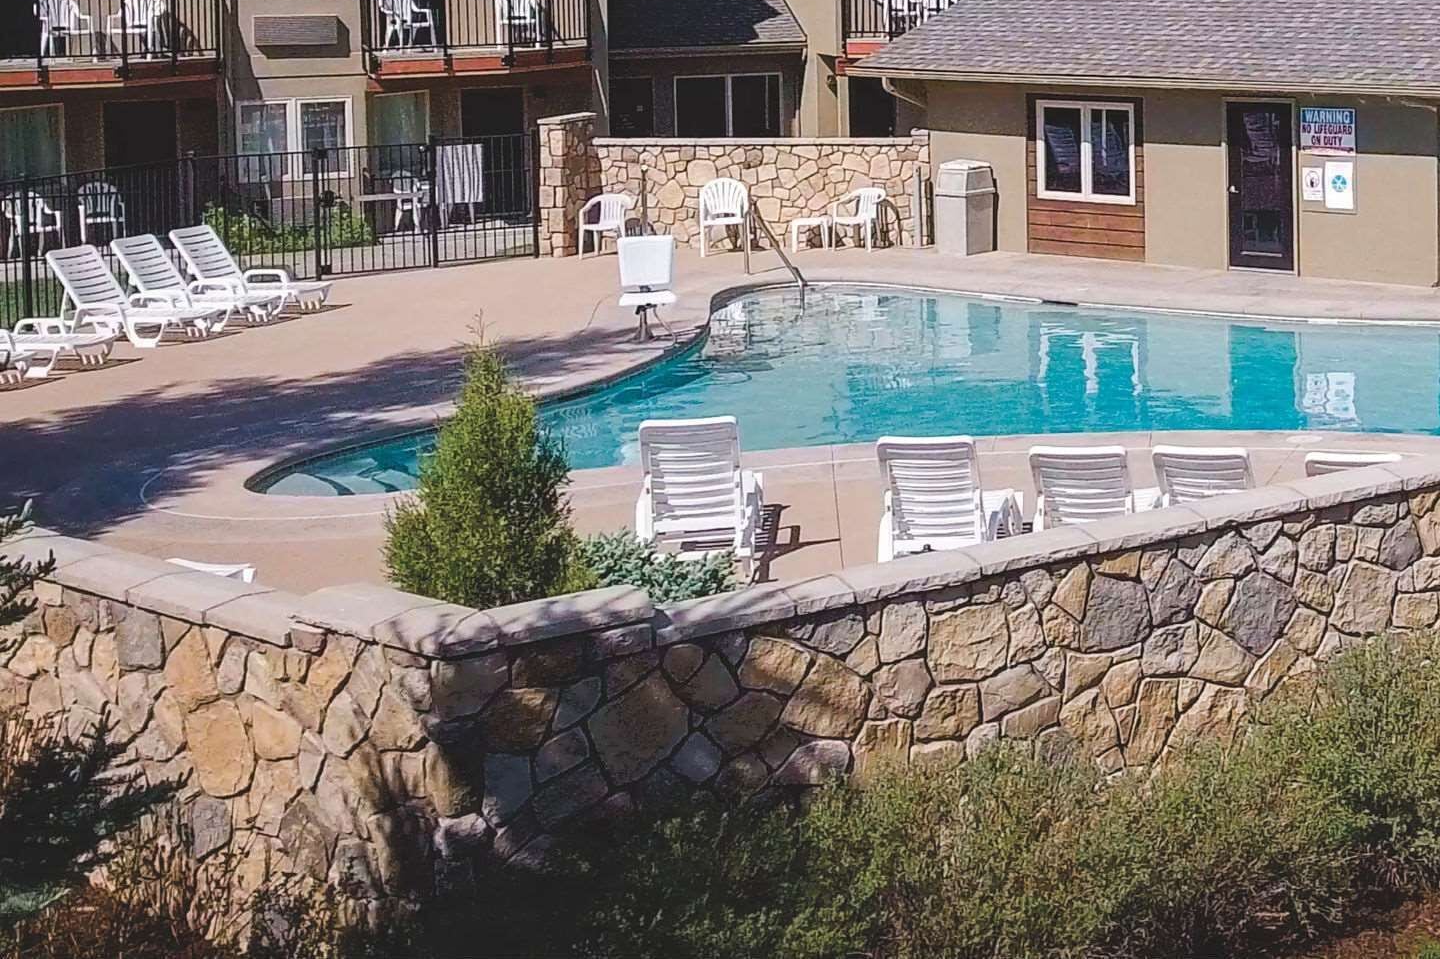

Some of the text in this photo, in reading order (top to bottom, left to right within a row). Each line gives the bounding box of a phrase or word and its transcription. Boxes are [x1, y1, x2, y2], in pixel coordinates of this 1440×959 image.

[1305, 110, 1350, 124] WARNING
[1302, 123, 1353, 136] NO LIFEGUARD
[1311, 135, 1343, 146] ON DUTY
